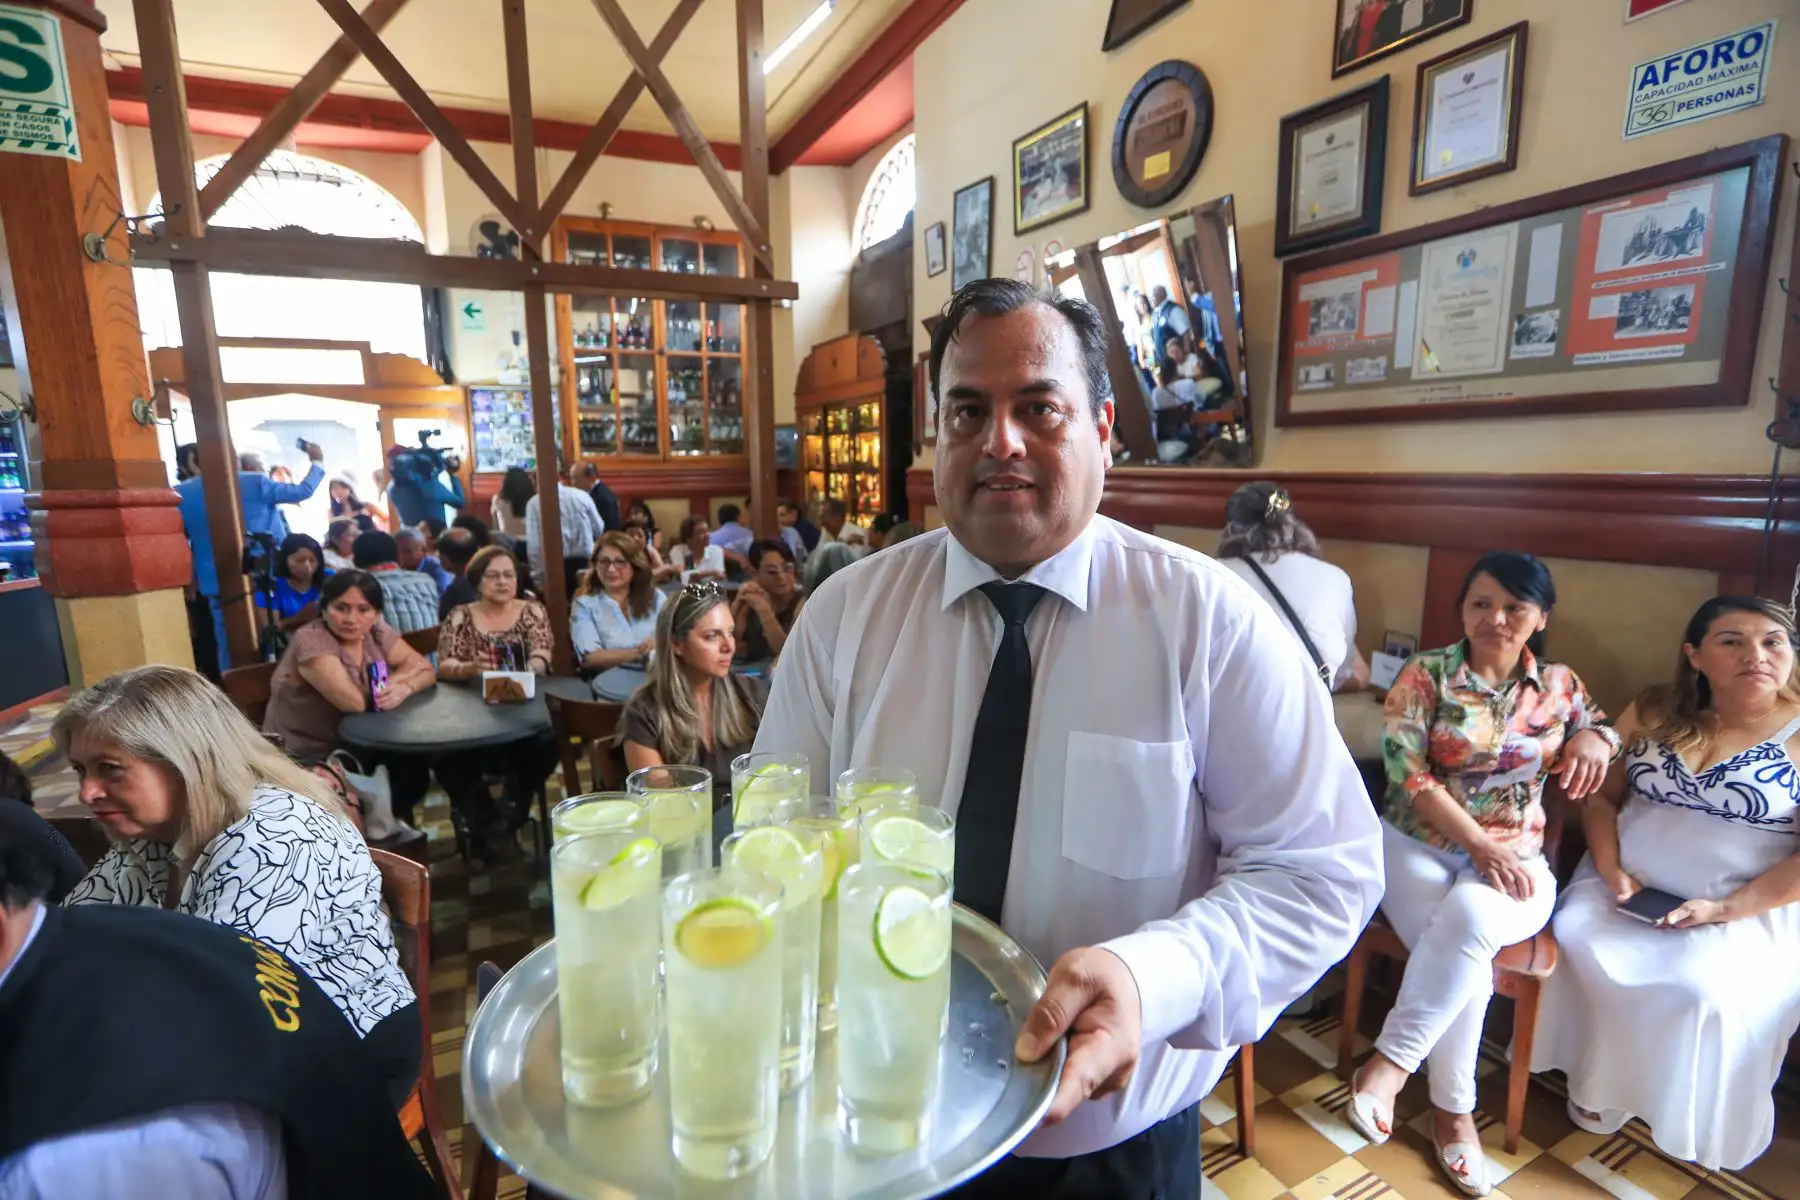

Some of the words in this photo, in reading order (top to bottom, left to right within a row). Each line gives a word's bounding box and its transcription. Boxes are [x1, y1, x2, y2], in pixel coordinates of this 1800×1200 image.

[1637, 31, 1764, 92] AFORO
[1635, 77, 1704, 104] CAPACIDAD
[1677, 83, 1756, 113] PERSONAS
[14, 122, 51, 132] CASOS
[16, 114, 61, 125] SEGURA
[12, 130, 55, 141] SISMOS
